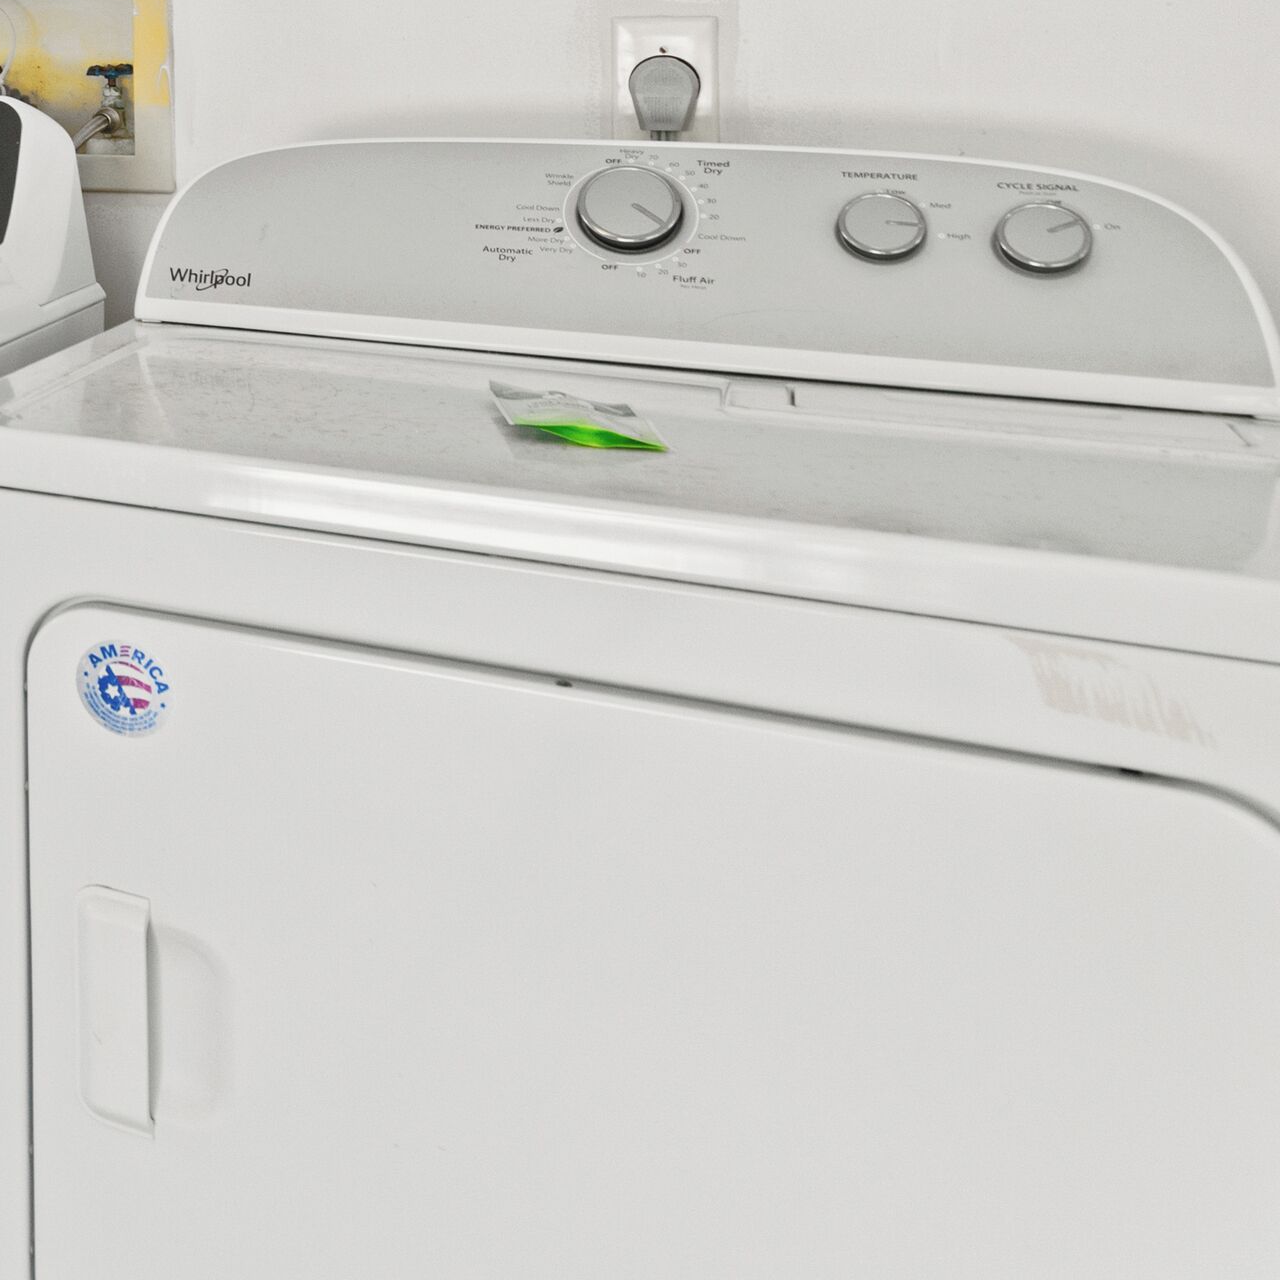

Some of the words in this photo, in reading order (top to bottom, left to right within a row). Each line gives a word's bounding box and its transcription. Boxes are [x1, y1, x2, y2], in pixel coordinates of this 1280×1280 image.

[697, 159, 730, 168] Timed
[703, 167, 723, 176] Dry
[841, 171, 918, 181] TEMPERATURE
[997, 182, 1033, 190] CYCLE
[1035, 183, 1079, 192] SIGNAL
[536, 204, 560, 212] Down
[506, 225, 551, 233] PREFERRED
[1104, 222, 1121, 230] On
[719, 234, 746, 242] Down
[946, 232, 971, 241] High
[483, 245, 533, 255] Automatic
[559, 246, 573, 254] Dry
[498, 253, 516, 262] Dry
[169, 267, 252, 292] Whirlpool
[673, 275, 697, 283] Fluff
[699, 277, 716, 285] Air
[88, 644, 169, 694] AMERICA
